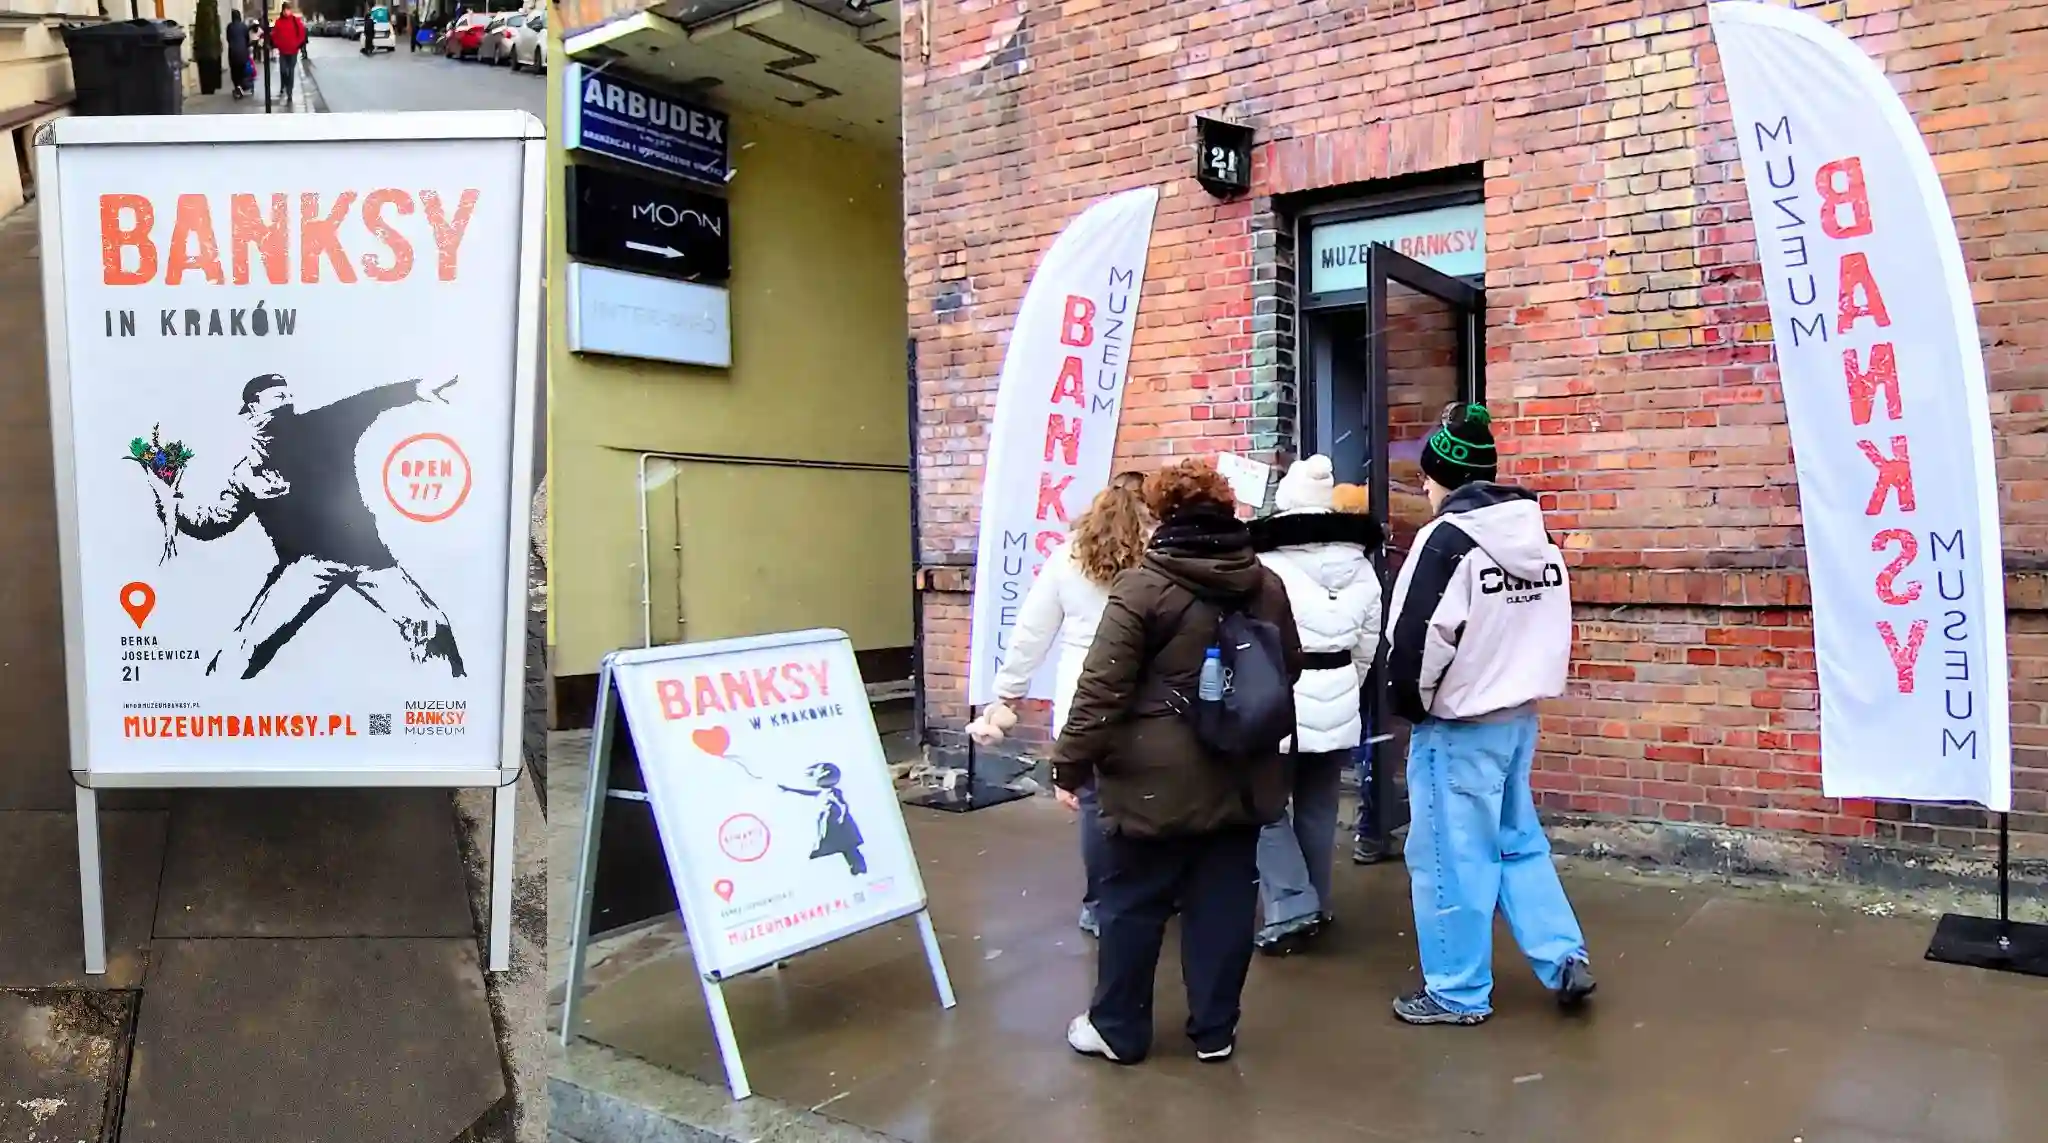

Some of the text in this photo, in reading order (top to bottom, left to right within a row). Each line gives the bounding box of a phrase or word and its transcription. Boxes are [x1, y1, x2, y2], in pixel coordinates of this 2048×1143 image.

[583, 78, 723, 144] ARBUDEX
[1211, 146, 1236, 171] 21
[100, 189, 480, 285] BANKSY
[1321, 229, 1478, 269] MUZE BANKSY
[105, 300, 297, 337] IN KRAKÓW
[1092, 266, 1133, 416] MUZEUM
[1032, 295, 1096, 578] BANKS
[401, 460, 452, 477] OPEN
[409, 483, 443, 500] 7/7
[121, 636, 158, 646] BERKA
[121, 650, 200, 661] JOSELEWICZA
[122, 666, 140, 682] 21
[656, 659, 830, 720] BANKSY
[405, 700, 467, 710] MUZEUM
[750, 703, 844, 730] W KRAKOWIE
[124, 715, 357, 737] MUZEUMBANKSY.PL
[405, 711, 465, 725] BANKSY
[405, 726, 466, 736] MUSEUM
